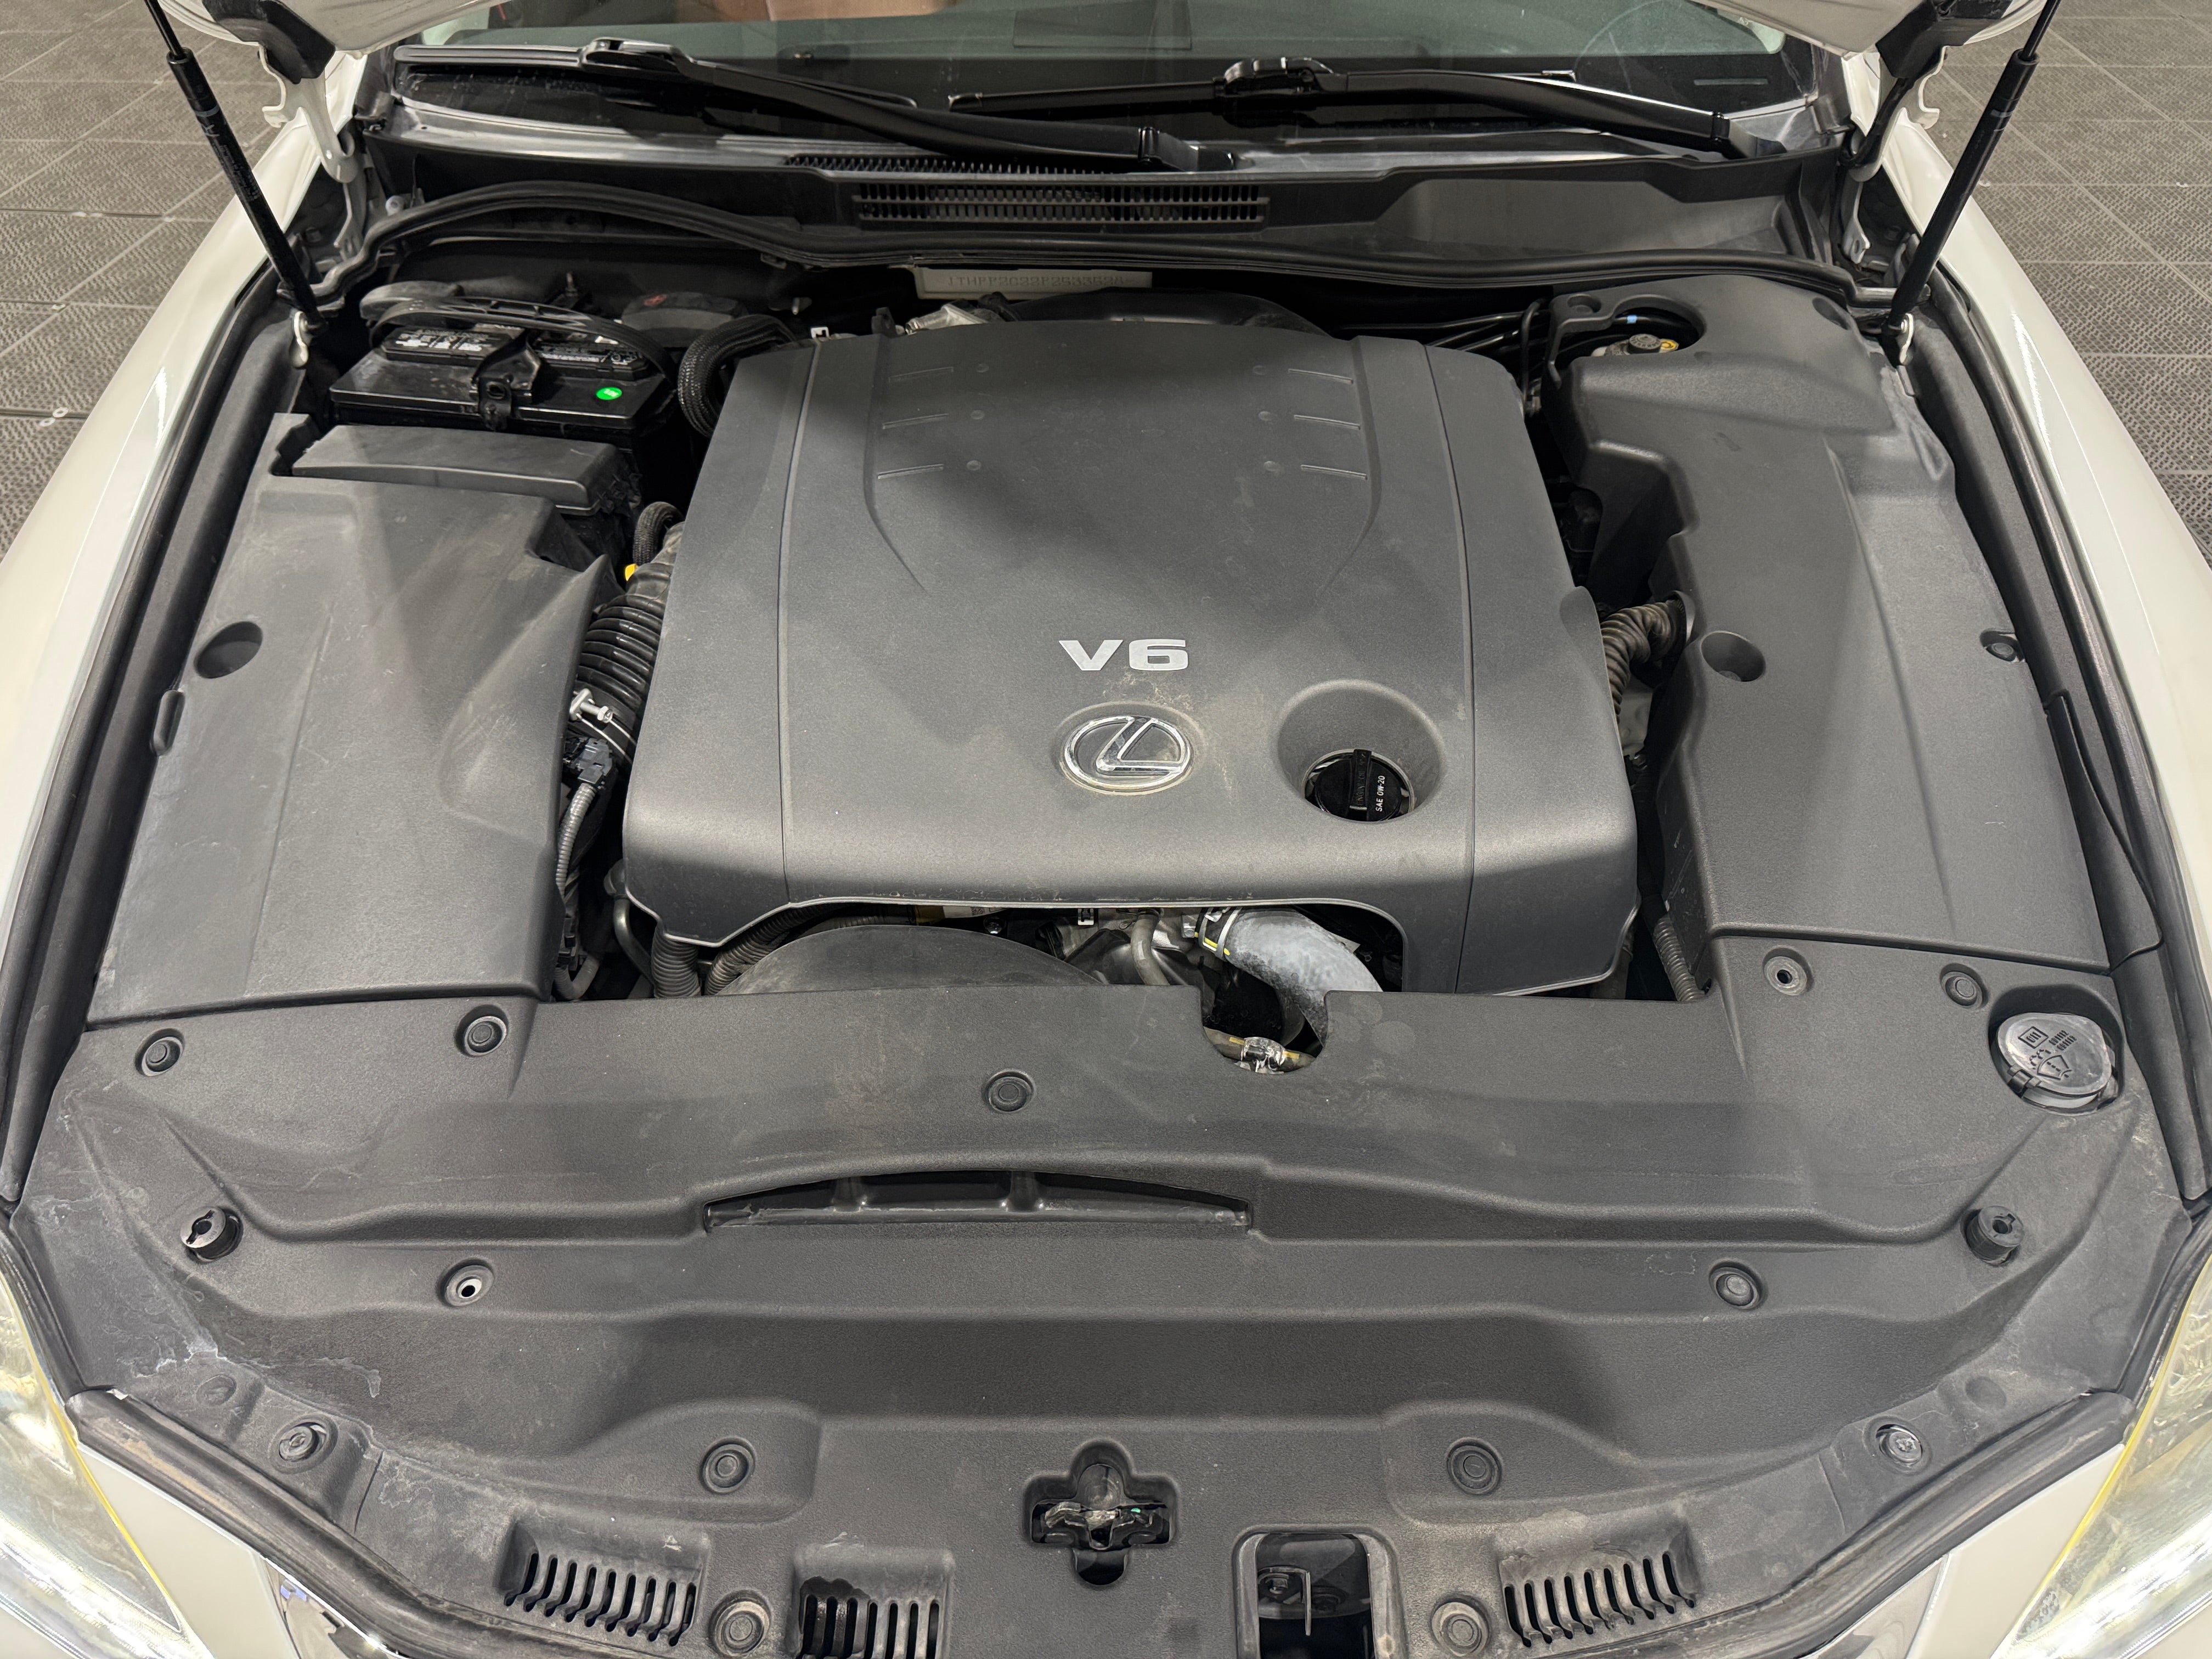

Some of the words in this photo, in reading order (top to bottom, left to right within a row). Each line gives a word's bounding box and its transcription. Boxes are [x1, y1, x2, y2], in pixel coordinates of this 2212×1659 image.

[1058, 639, 1189, 671] V6
[1377, 775, 1385, 796] 0W-20
[1375, 798, 1383, 812] SAE
